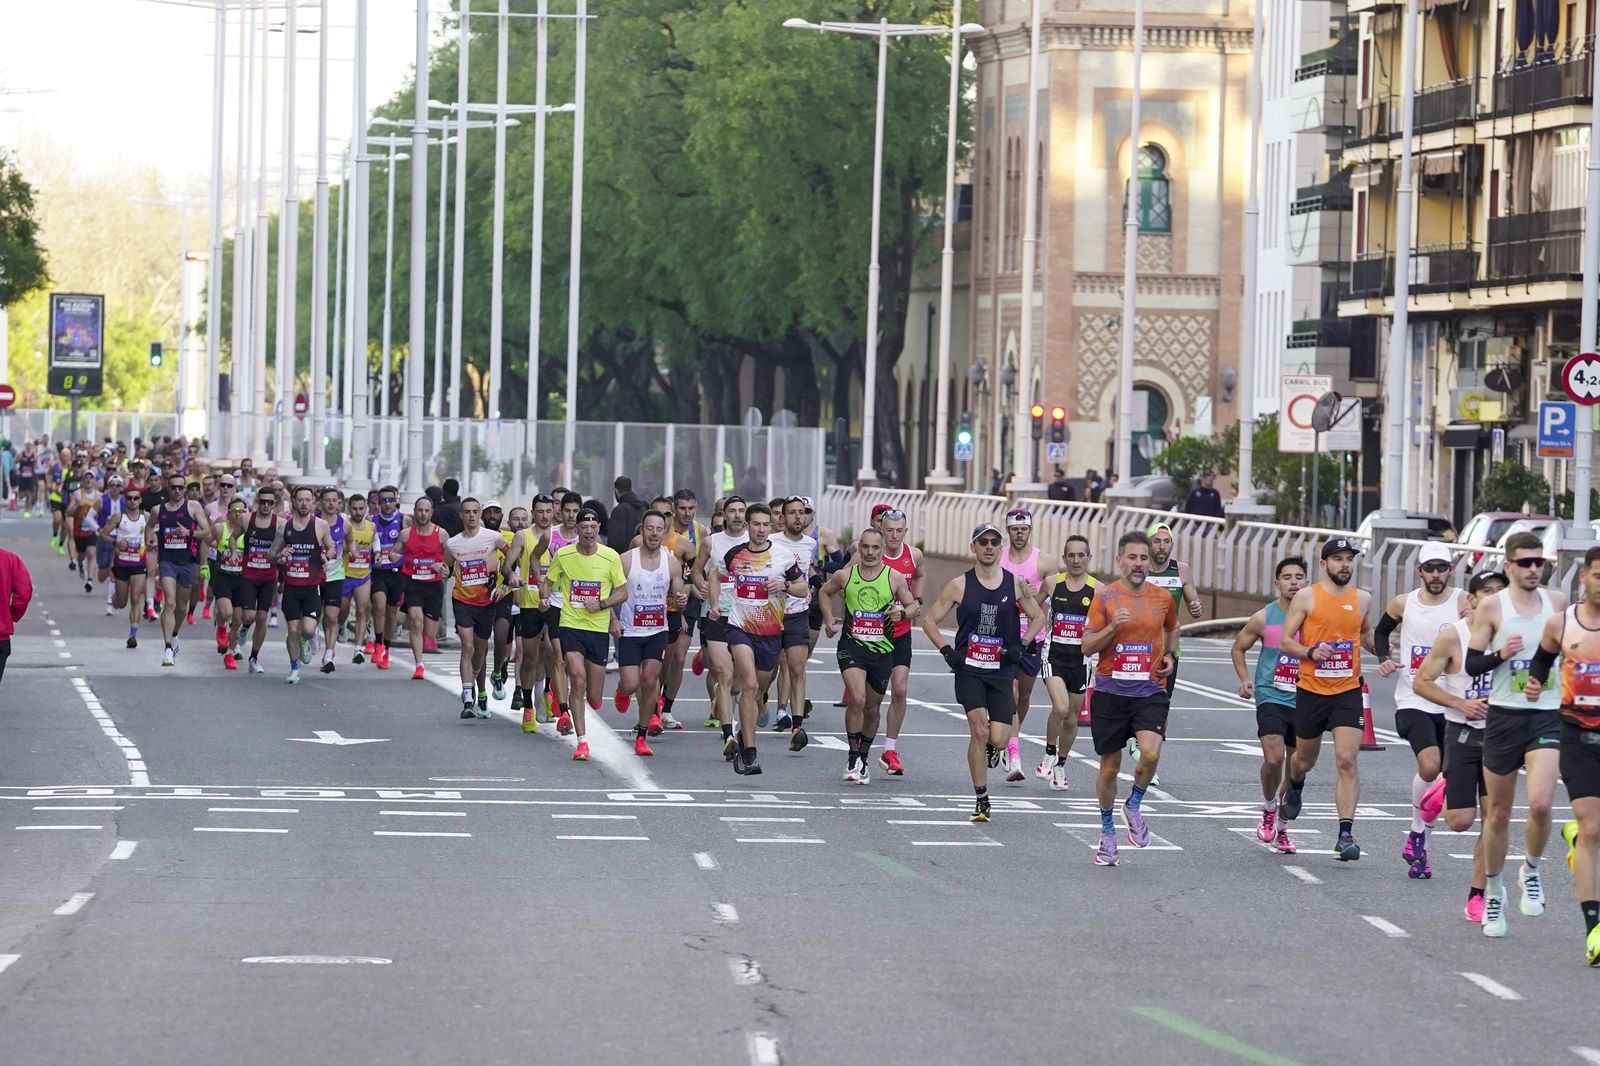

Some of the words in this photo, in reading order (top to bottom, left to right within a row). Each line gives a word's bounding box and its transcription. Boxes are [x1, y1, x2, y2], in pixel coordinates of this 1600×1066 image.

[1543, 406, 1566, 436] P
[980, 603, 998, 614] RUN
[980, 614, 997, 626] THE
[852, 626, 883, 635] PEPPUZZO
[977, 624, 997, 636] CITY
[972, 652, 996, 661] MARCO
[1122, 663, 1142, 671] SERY
[1321, 661, 1349, 669] DELBOE
[1273, 675, 1293, 684] PABLO
[27, 788, 462, 799] MOTO
